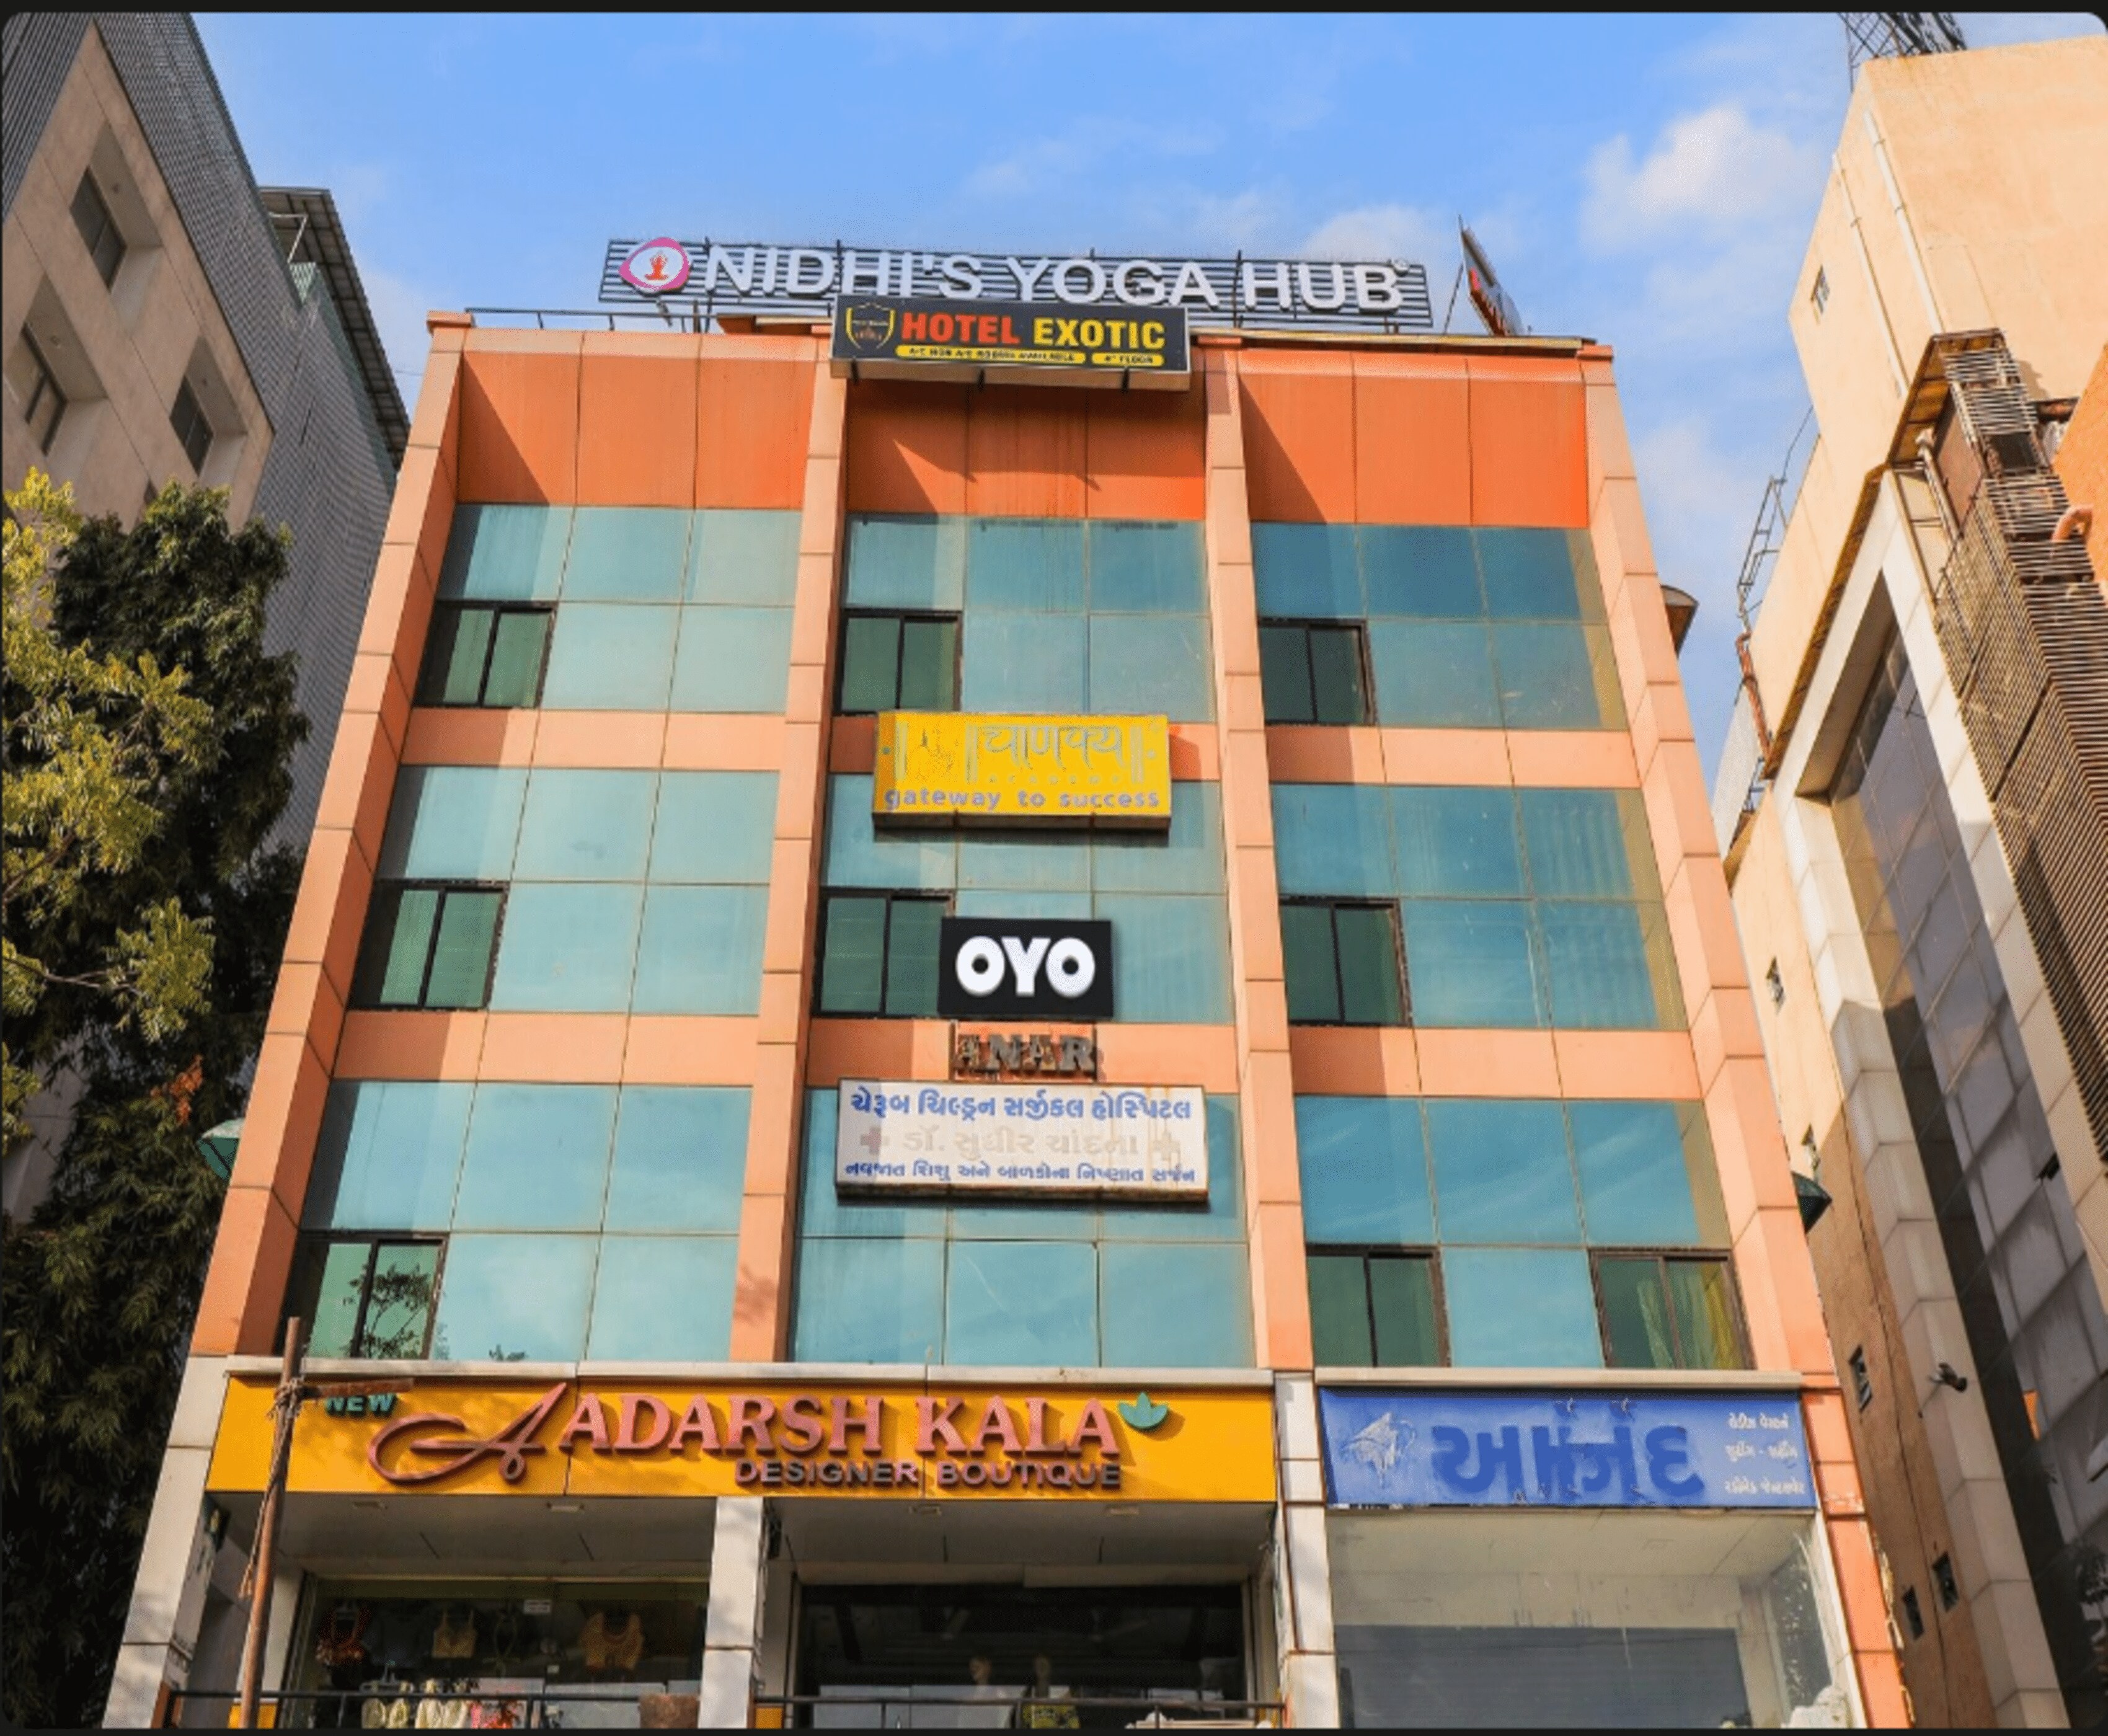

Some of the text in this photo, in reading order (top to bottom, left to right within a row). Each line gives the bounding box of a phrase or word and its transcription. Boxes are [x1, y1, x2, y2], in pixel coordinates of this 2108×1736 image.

[705, 245, 1402, 313] NIDHI'S YOGA HUB
[901, 312, 1166, 349] HOTEL EXOTIC
[884, 787, 1160, 811] gateway to success
[955, 936, 1096, 998] OYO
[325, 1393, 399, 1415] NEW
[914, 1395, 1120, 1458] KALA
[734, 1458, 1121, 1490] DESIGNER BOUTIQUE
